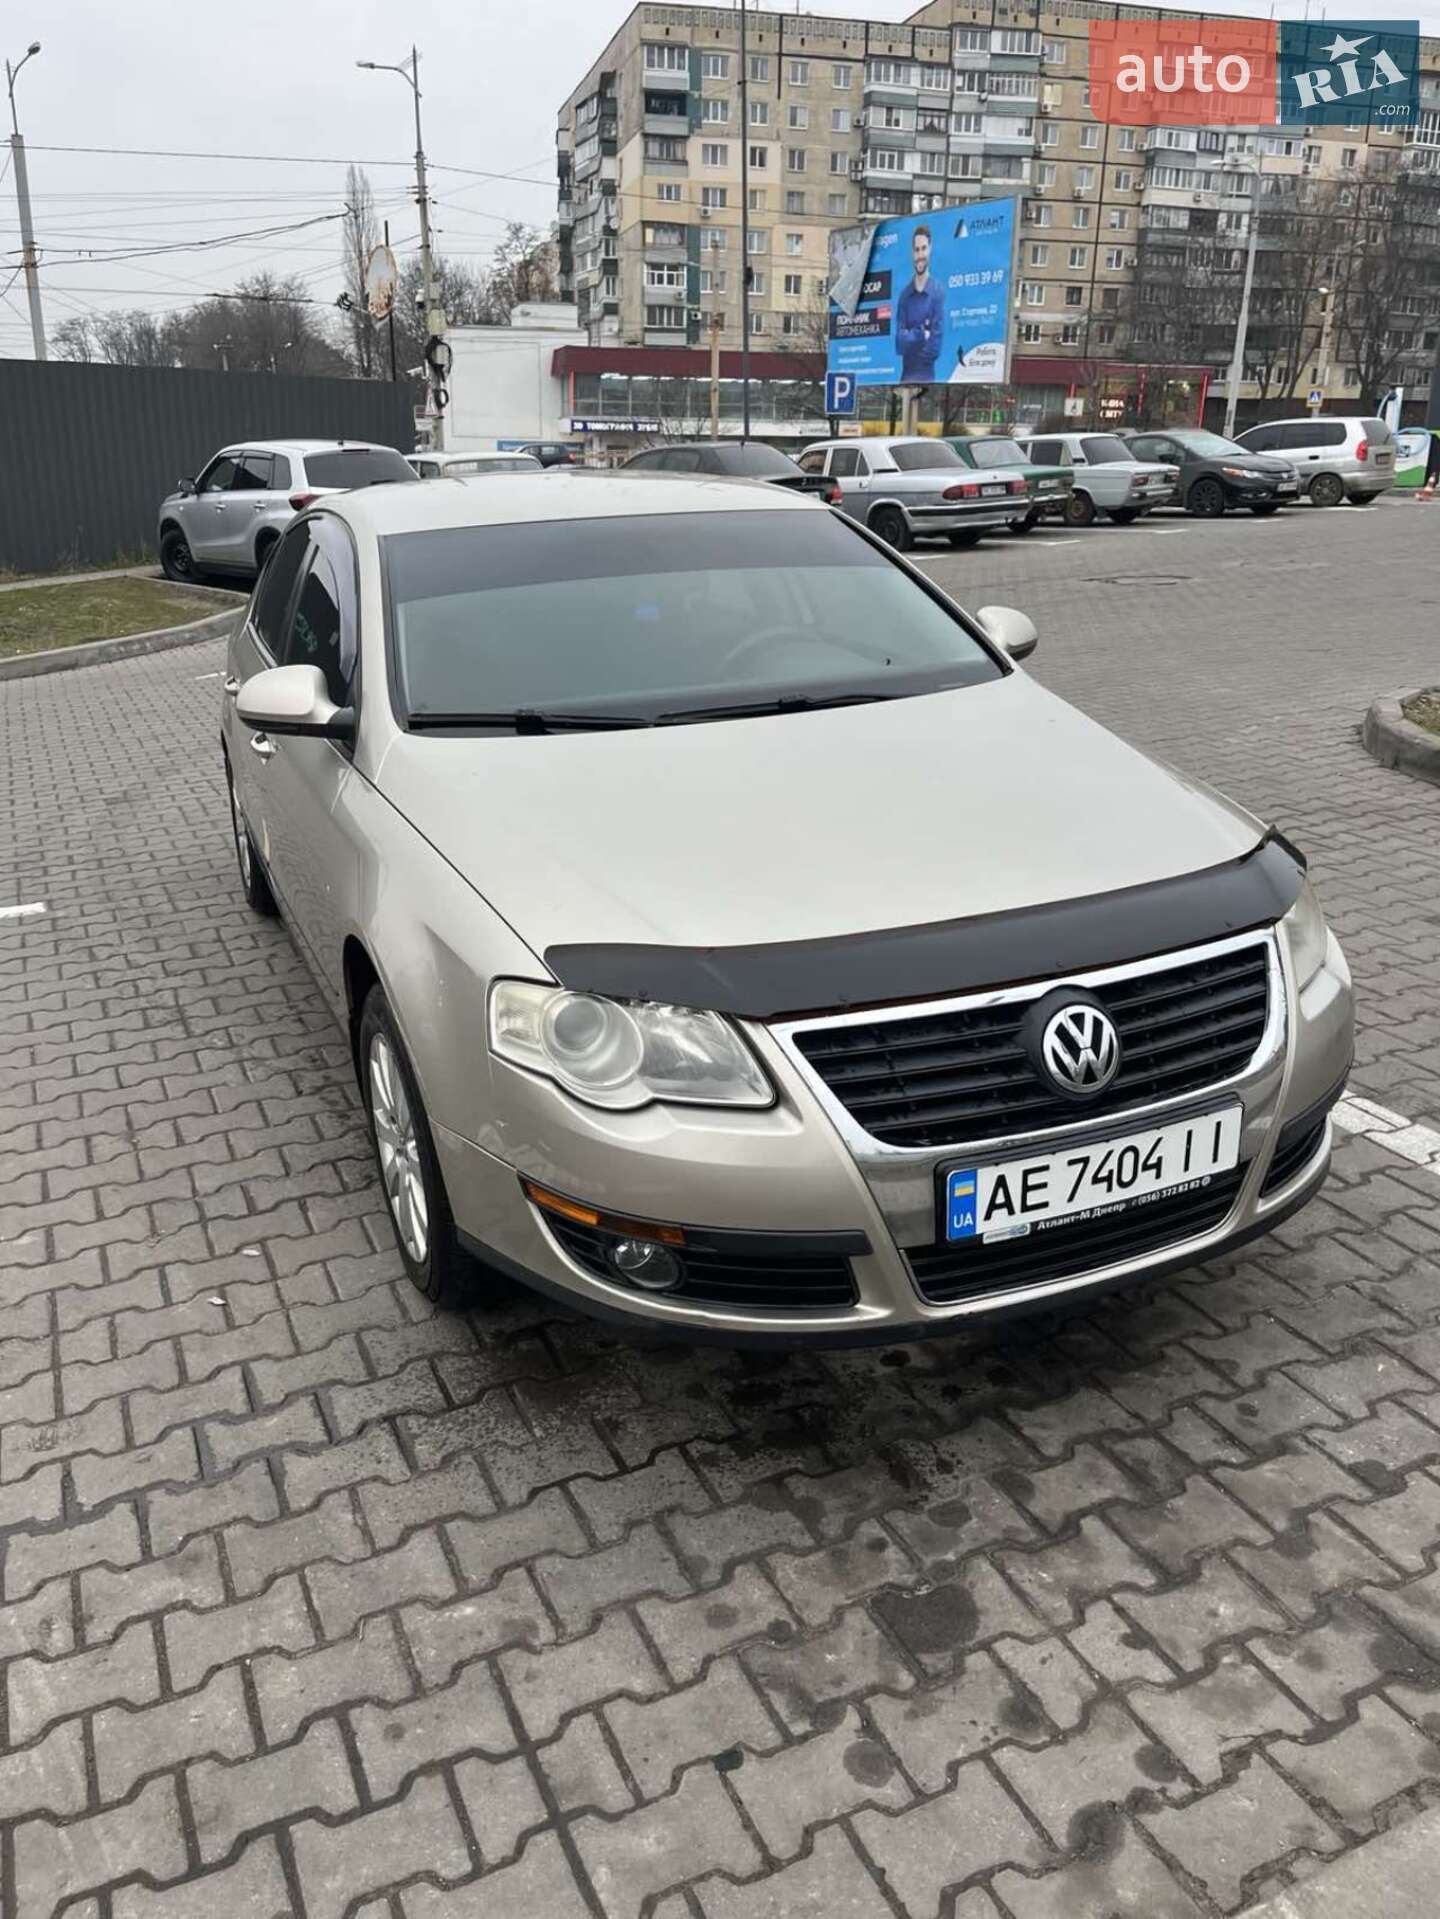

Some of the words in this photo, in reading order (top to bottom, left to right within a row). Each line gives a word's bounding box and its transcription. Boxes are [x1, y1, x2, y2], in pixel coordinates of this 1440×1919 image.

[949, 274, 963, 288] 050
[834, 376, 850, 409] P
[984, 1165, 1050, 1222] AE
[1066, 1136, 1163, 1203] 7404
[953, 1212, 974, 1228] UA
[1037, 1210, 1091, 1231] Атлант-М
[1092, 1202, 1126, 1219] Днепр
